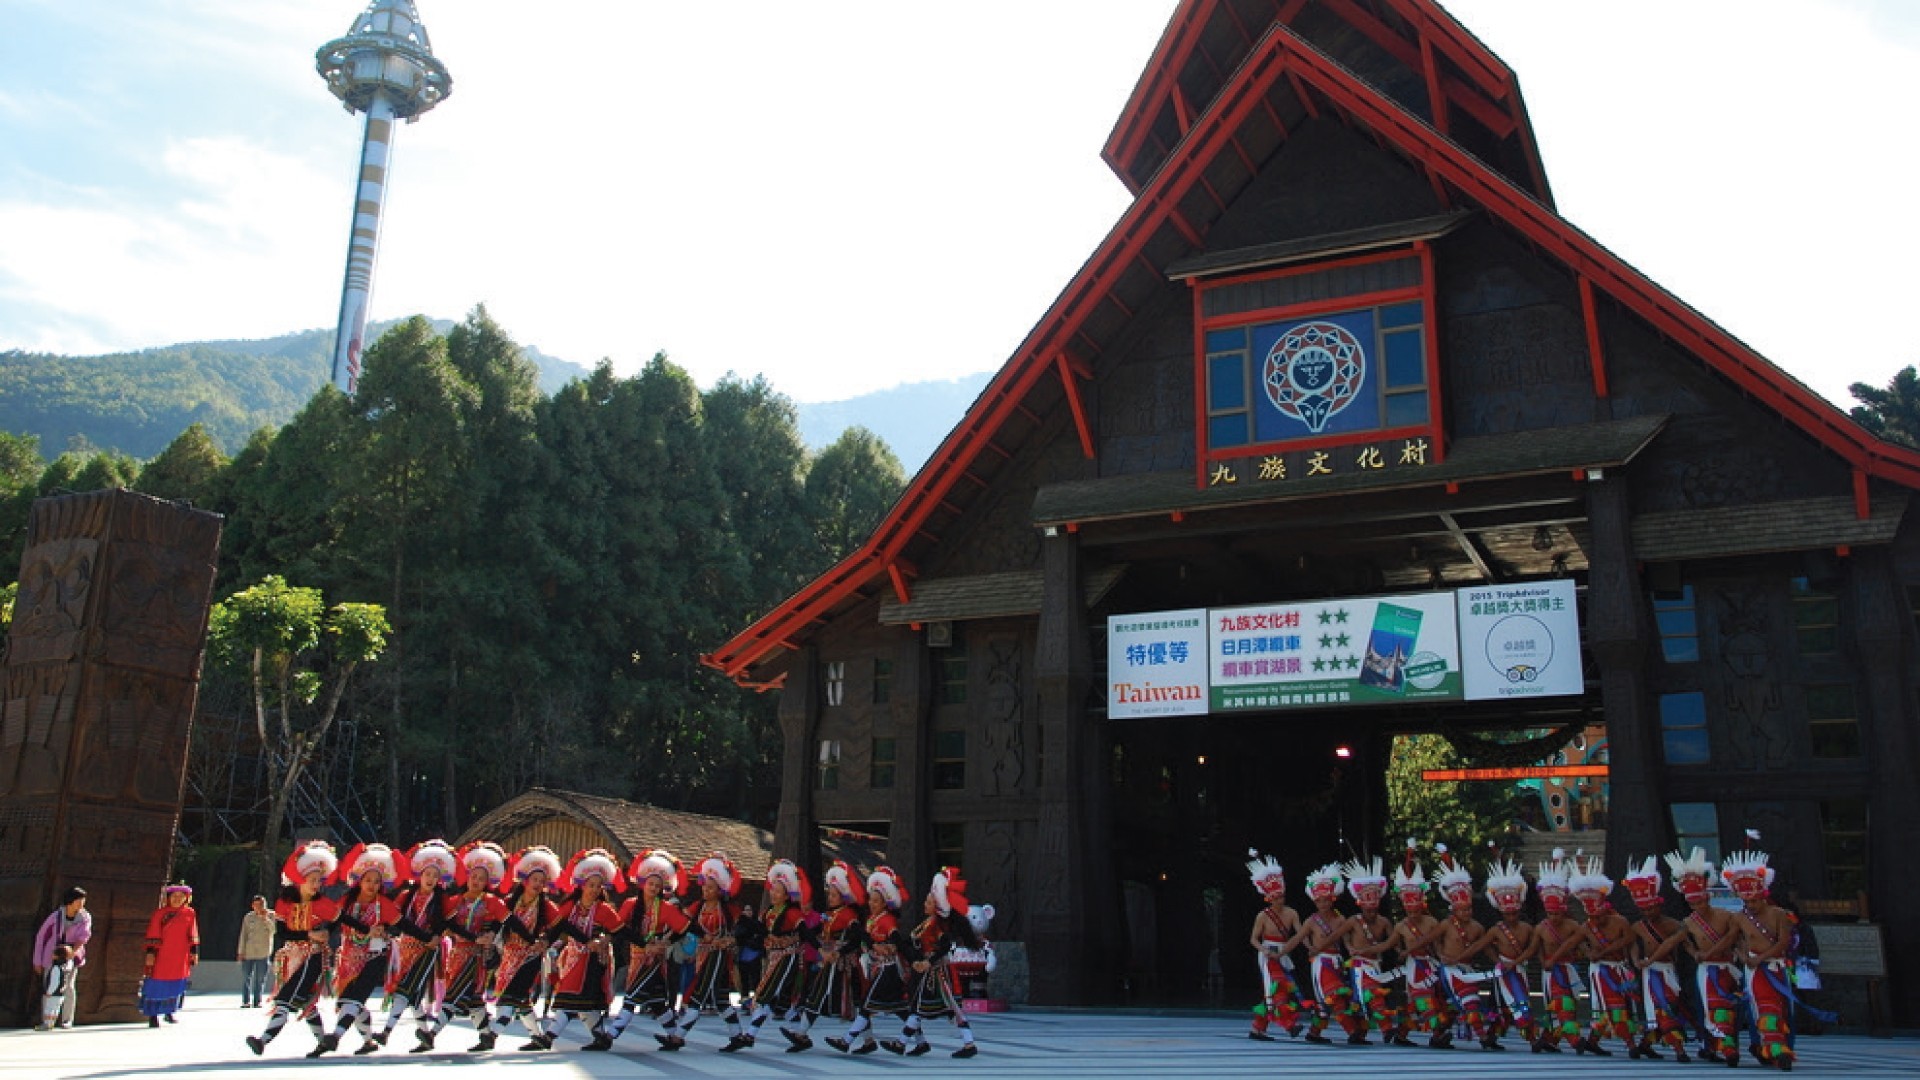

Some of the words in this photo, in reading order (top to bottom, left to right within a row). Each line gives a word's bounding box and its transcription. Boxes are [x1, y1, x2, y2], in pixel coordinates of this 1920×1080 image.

[1210, 438, 1428, 485] 九族文化村
[1470, 592, 1493, 601] 2015
[1497, 588, 1550, 600] TripAdvisor
[1220, 610, 1300, 632] 九族文化村
[1126, 641, 1188, 667] 特優等
[1222, 635, 1300, 655] 日月潭纜車
[1113, 681, 1202, 704] Taiwan
